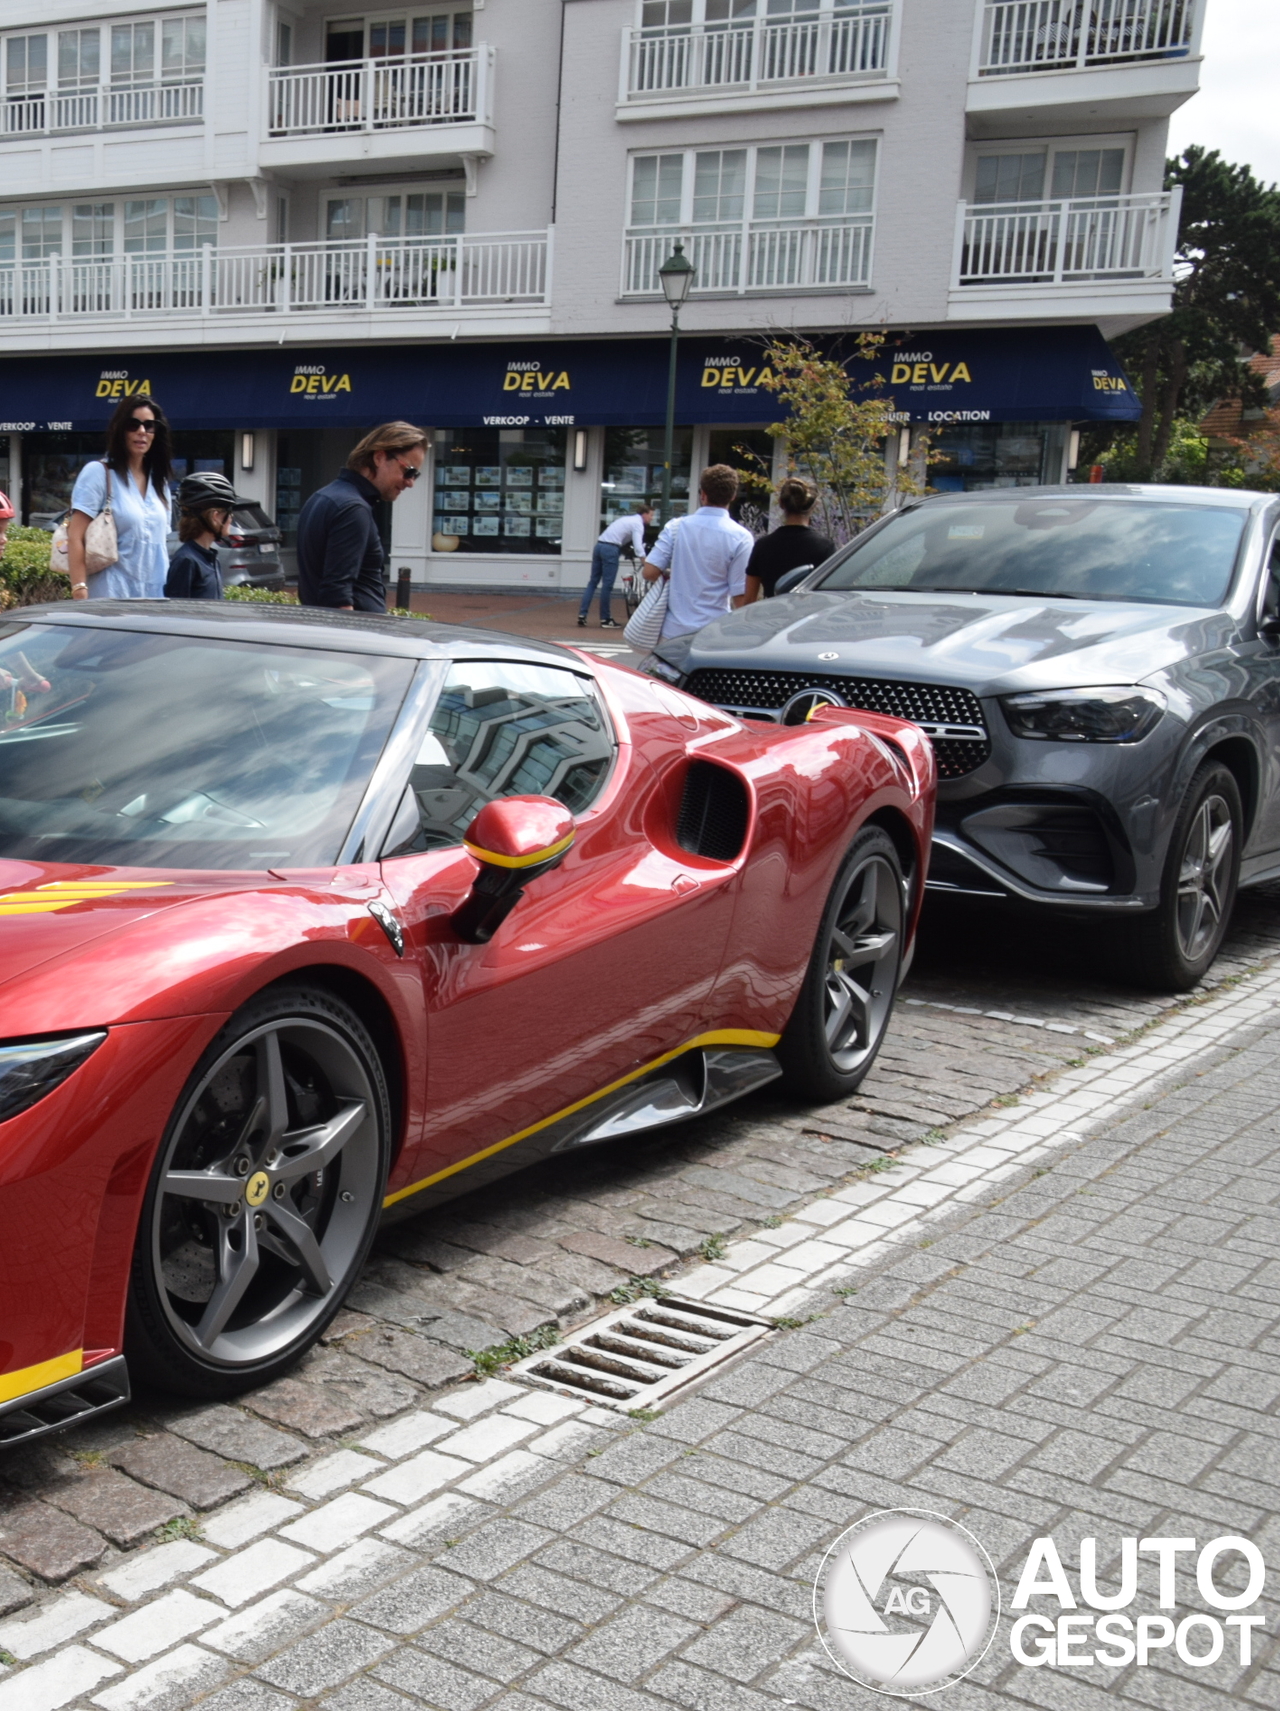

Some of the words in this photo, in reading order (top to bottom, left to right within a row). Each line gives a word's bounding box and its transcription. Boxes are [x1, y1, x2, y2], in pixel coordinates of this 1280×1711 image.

[704, 356, 740, 366] IMMO
[894, 352, 932, 362] IMMO
[294, 366, 325, 374] IMMO
[507, 362, 540, 371] IMMO
[100, 370, 128, 379] IMMO
[701, 367, 774, 387] DEVA
[890, 362, 972, 384] DEVA
[290, 374, 351, 393] DEVA
[503, 372, 570, 390] DEVA
[1093, 377, 1126, 390] DEVA
[96, 380, 151, 397] DEVA
[483, 416, 530, 425] VERKOOP
[544, 416, 575, 425] VENTE
[928, 410, 990, 421] LOCATION
[47, 422, 73, 430] VENTE
